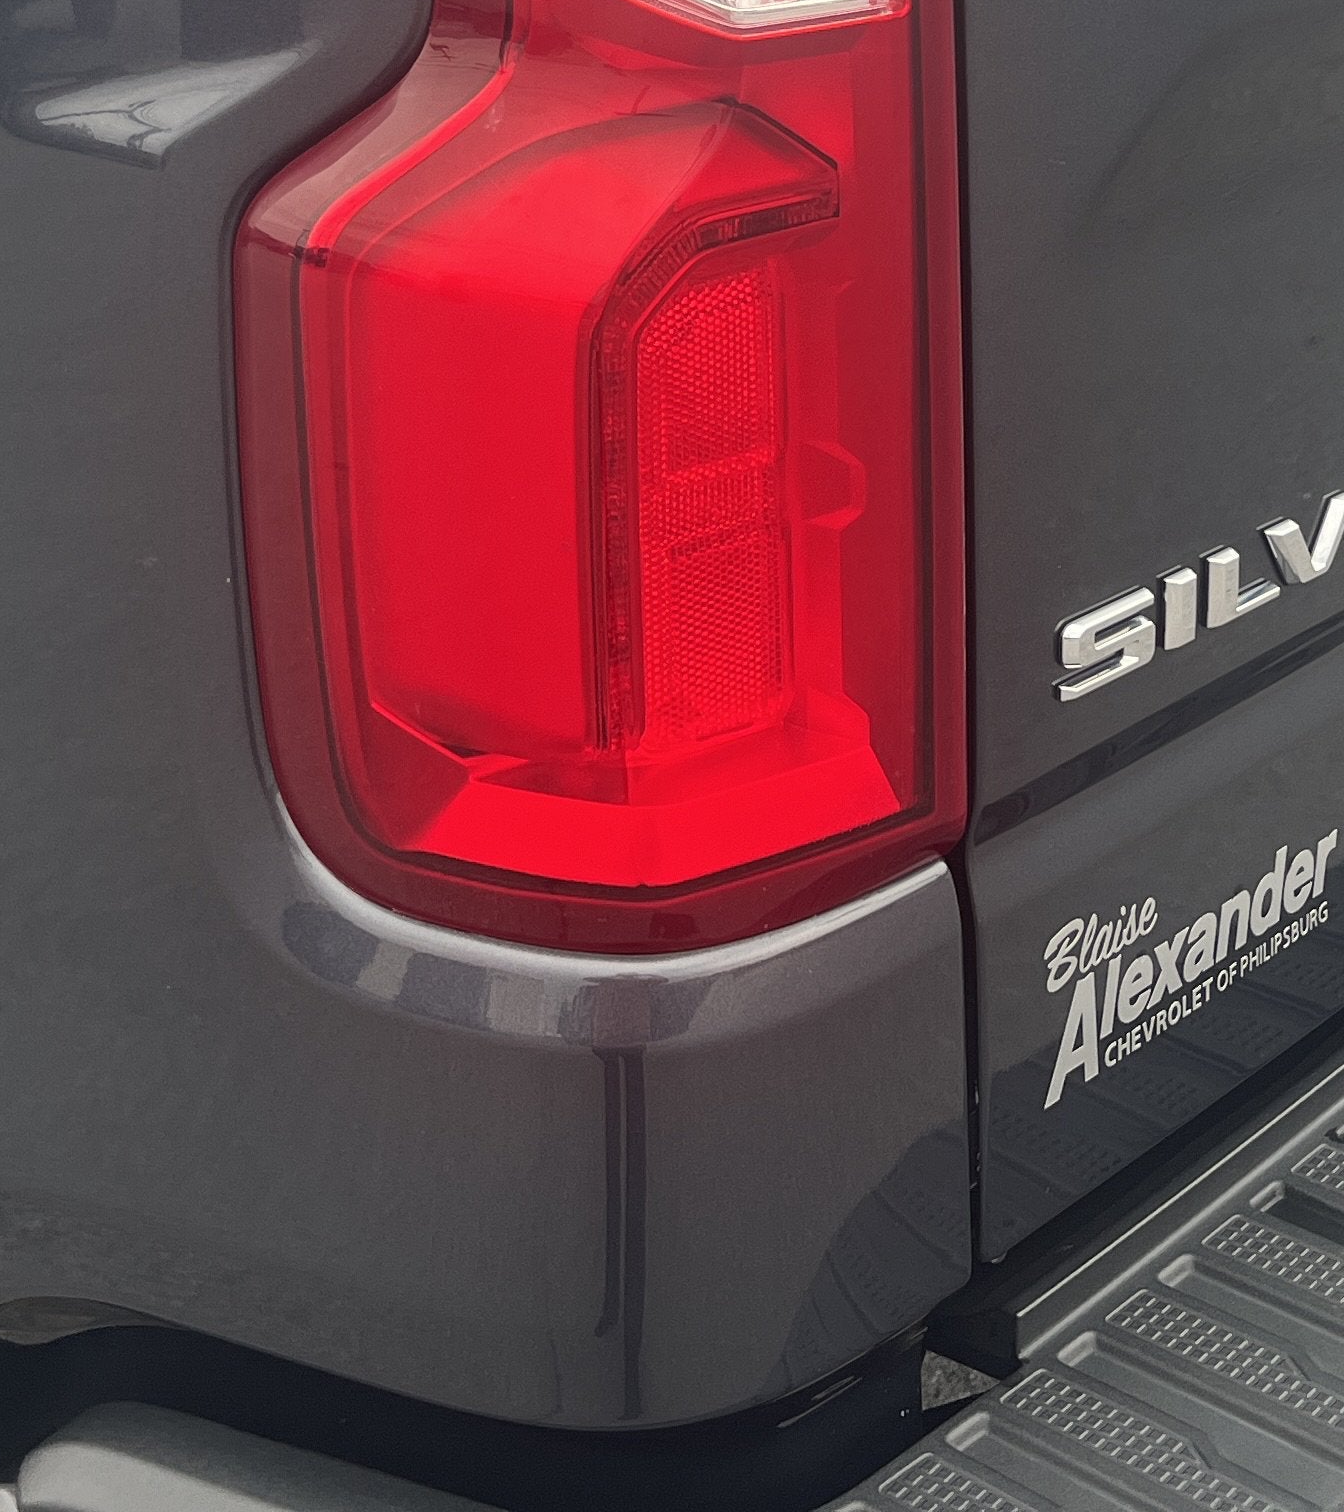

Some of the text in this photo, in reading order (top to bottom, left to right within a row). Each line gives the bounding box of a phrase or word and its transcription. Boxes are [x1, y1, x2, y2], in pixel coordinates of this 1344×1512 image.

[1044, 896, 1158, 993] Blaise
[1044, 828, 1339, 1110] Alexander
[1104, 900, 1329, 1068] CHEVROLET OF PHILIPSBURG
